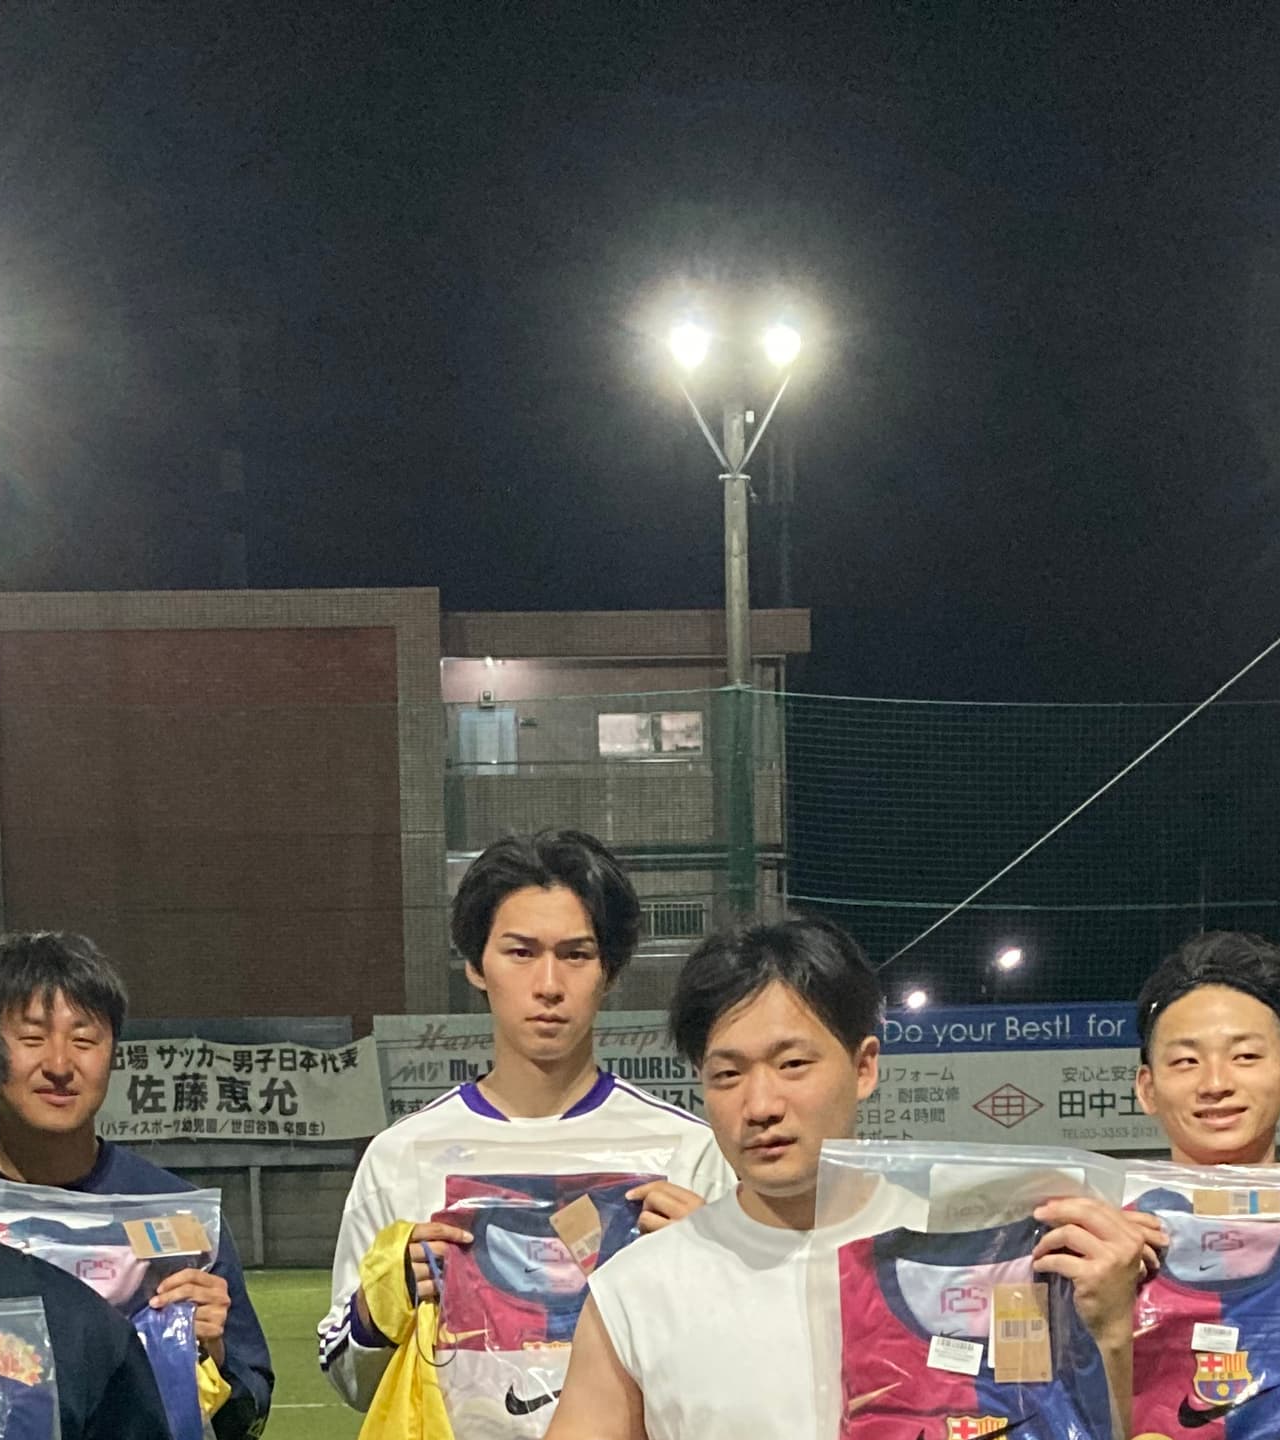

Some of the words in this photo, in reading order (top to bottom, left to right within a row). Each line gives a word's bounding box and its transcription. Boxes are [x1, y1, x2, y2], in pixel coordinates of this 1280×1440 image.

[882, 1018, 923, 1044] Do
[931, 1021, 997, 1048] your
[1004, 1013, 1071, 1041] Best!
[1086, 1013, 1127, 1038] for
[155, 1042, 360, 1074] サッカー男子日本代表
[602, 1056, 701, 1080] TOURIS
[126, 1072, 299, 1117] 佐藤恵允
